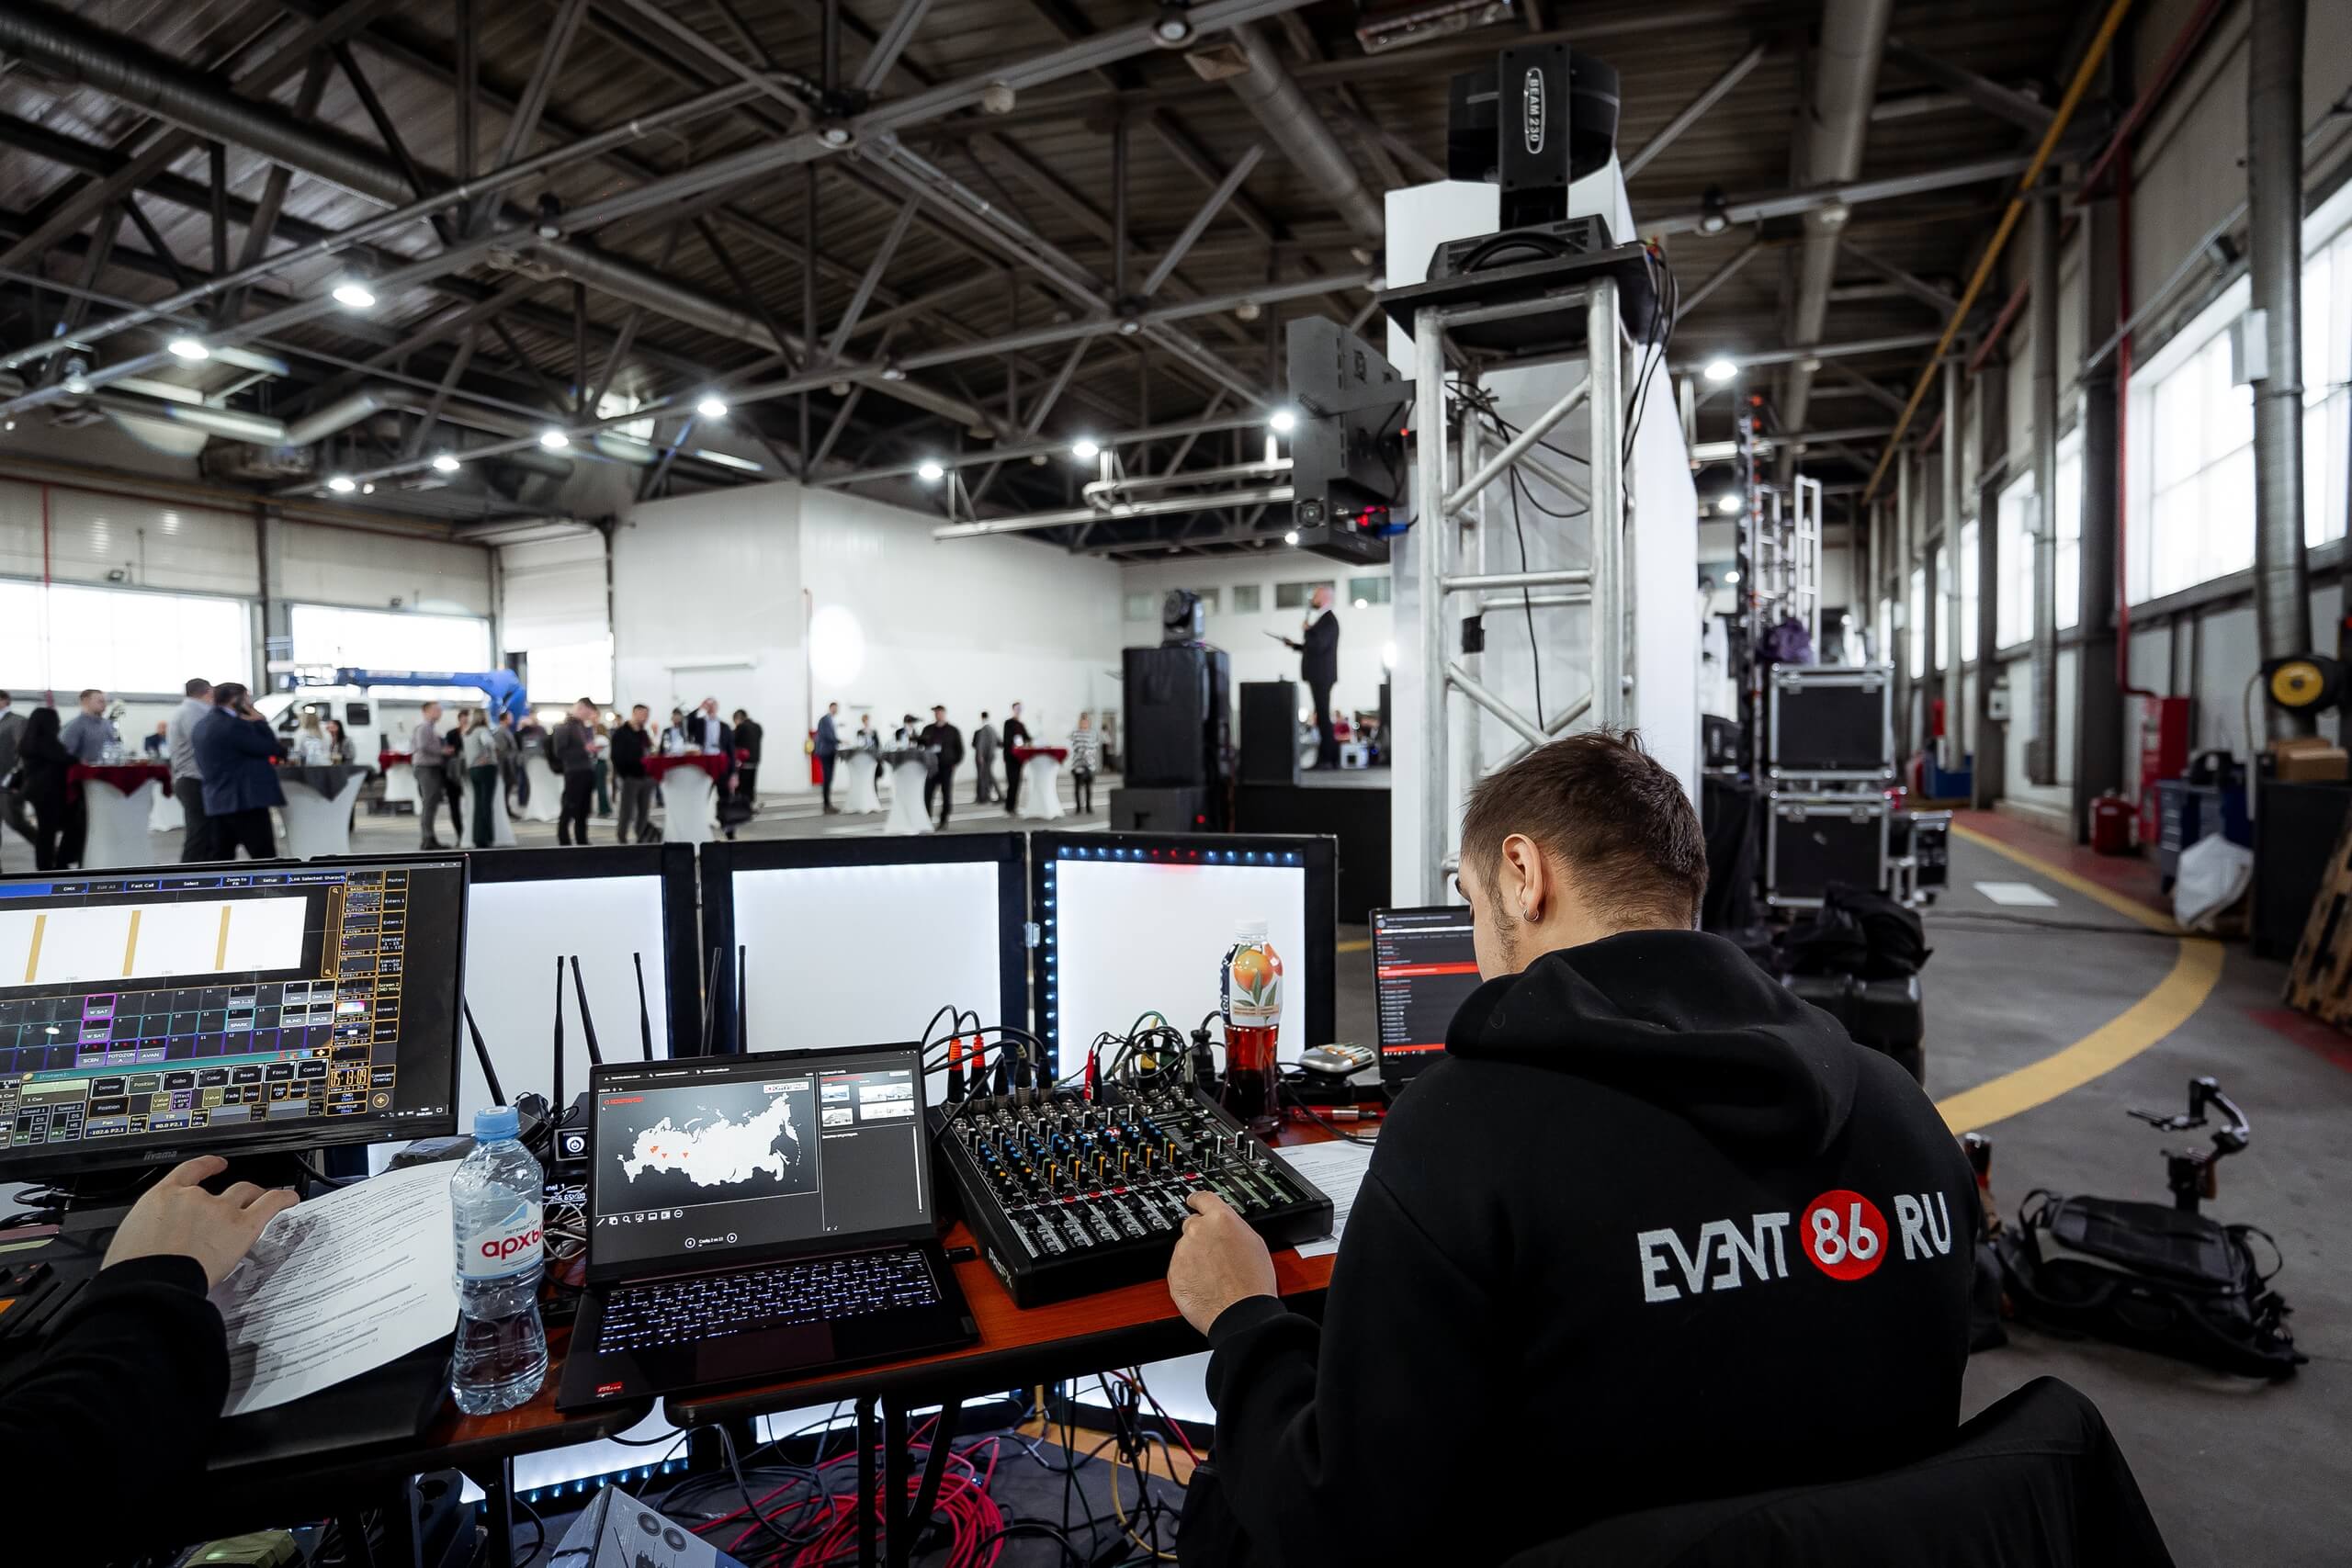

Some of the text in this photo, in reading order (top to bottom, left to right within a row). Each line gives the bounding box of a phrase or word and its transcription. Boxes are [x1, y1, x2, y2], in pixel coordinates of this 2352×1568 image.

[1529, 78, 1541, 142] BEAM 230
[143, 1151, 177, 1161] iiyama
[988, 1247, 1013, 1289] PROFX
[1637, 1191, 1951, 1303] EVENT 86 RU
